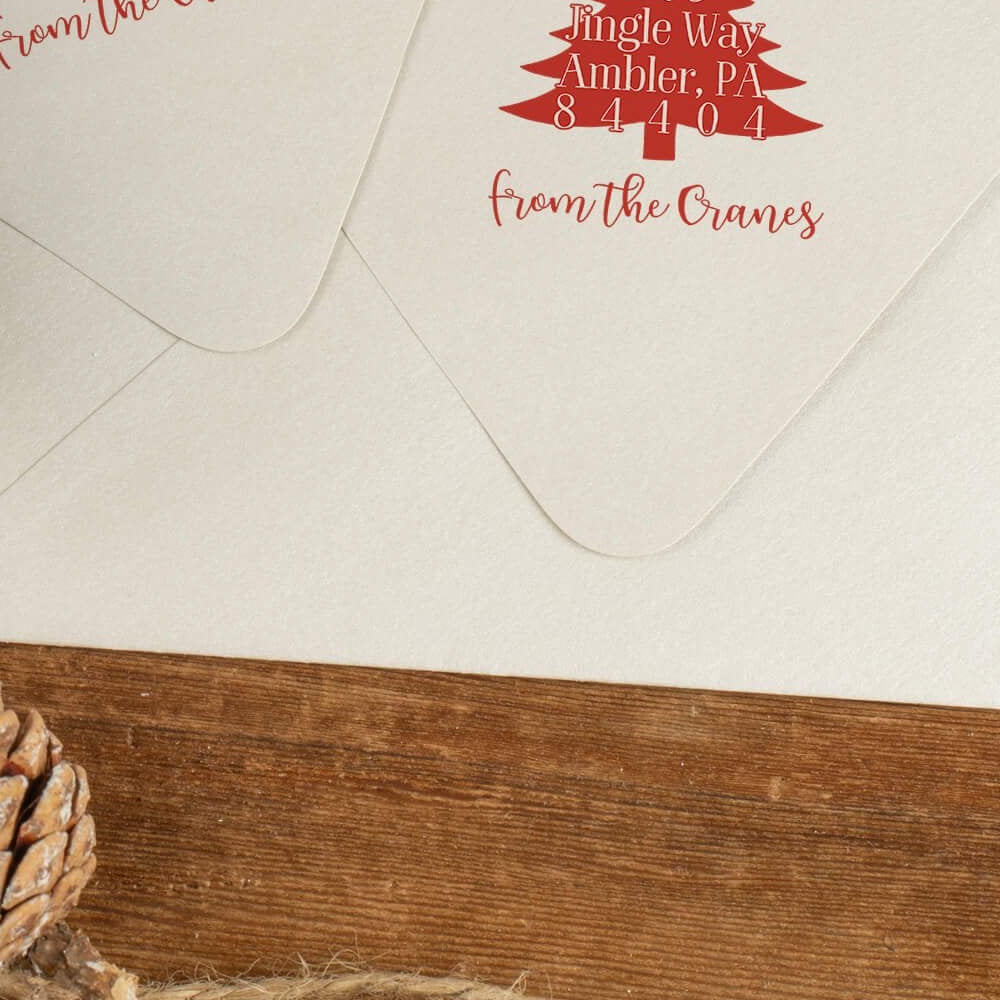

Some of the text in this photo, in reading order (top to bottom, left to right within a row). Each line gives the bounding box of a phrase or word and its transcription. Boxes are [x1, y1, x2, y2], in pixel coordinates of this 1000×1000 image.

[564, 3, 767, 57] Jingle Way
[556, 52, 767, 99] Ambler, PA
[488, 168, 824, 240] from the Cranes
